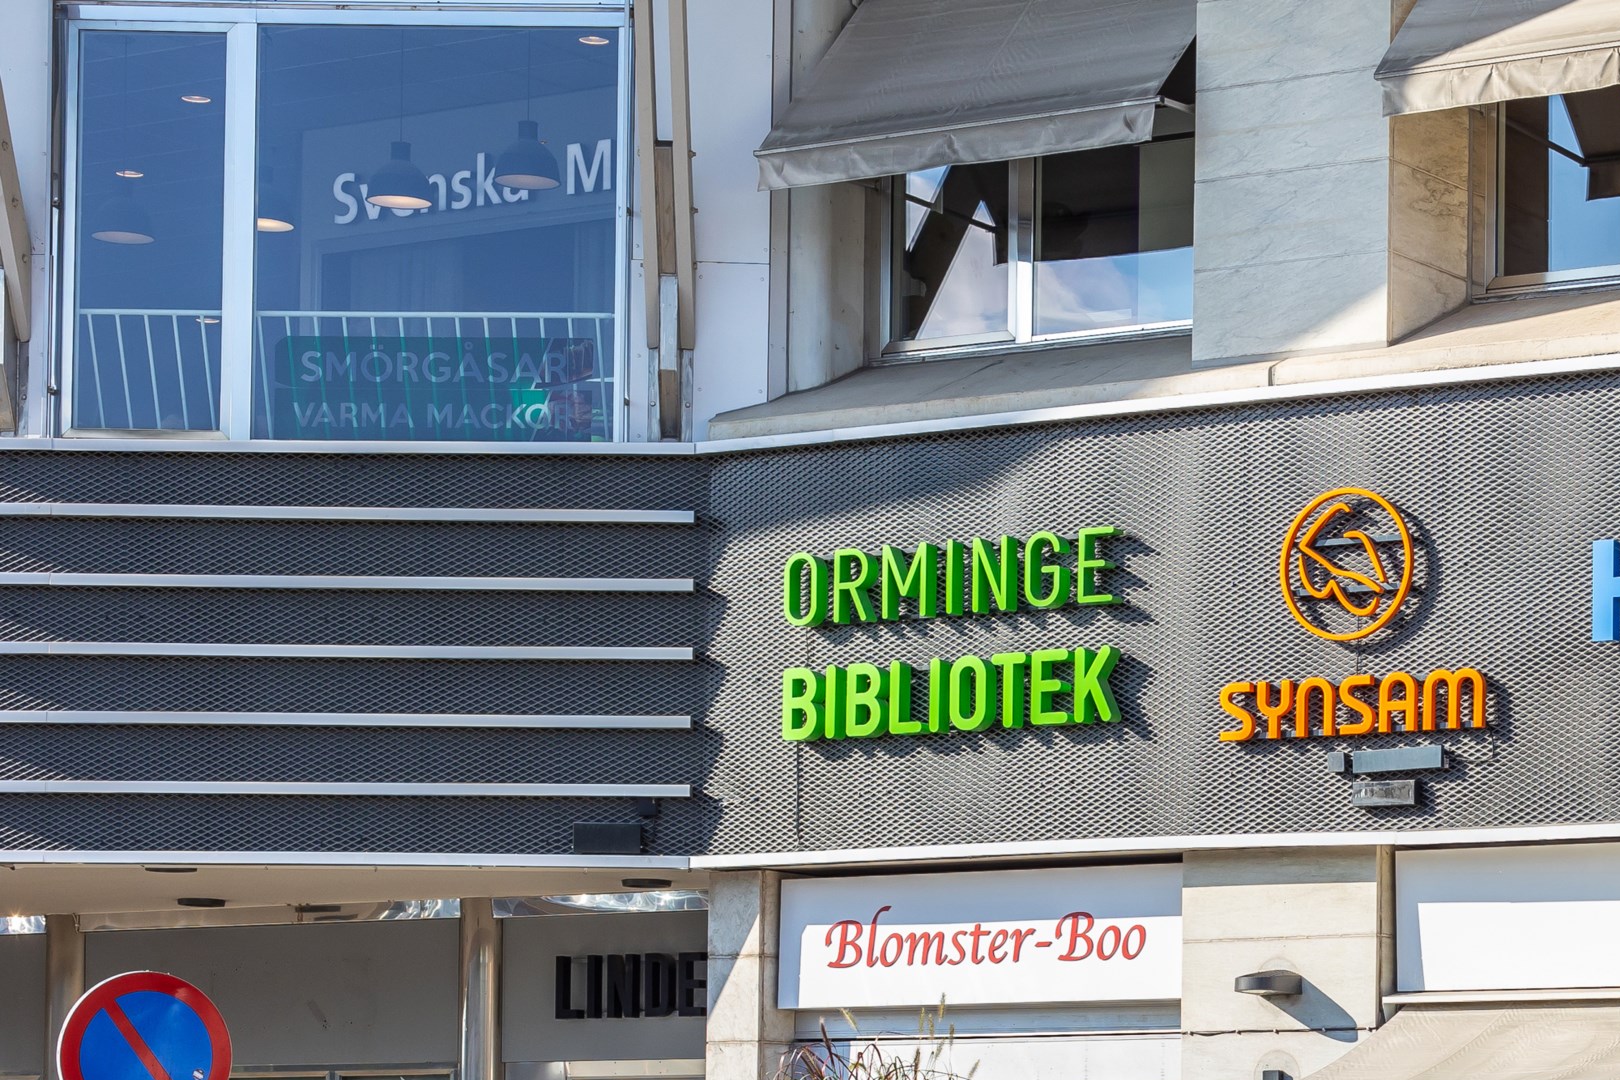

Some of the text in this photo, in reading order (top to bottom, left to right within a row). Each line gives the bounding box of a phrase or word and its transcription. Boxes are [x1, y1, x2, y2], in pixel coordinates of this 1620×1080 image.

[333, 152, 529, 224] Svnsk
[301, 342, 568, 383] SMÖRGÅSAR
[293, 402, 572, 430] VARMA MACKOR
[784, 526, 1125, 628] ORMINGE
[782, 645, 1122, 741] BIBLIOTEK
[1219, 667, 1487, 742] SYNSAM
[825, 905, 1147, 970] Blomster-Boo
[555, 952, 708, 1019] LINDE
